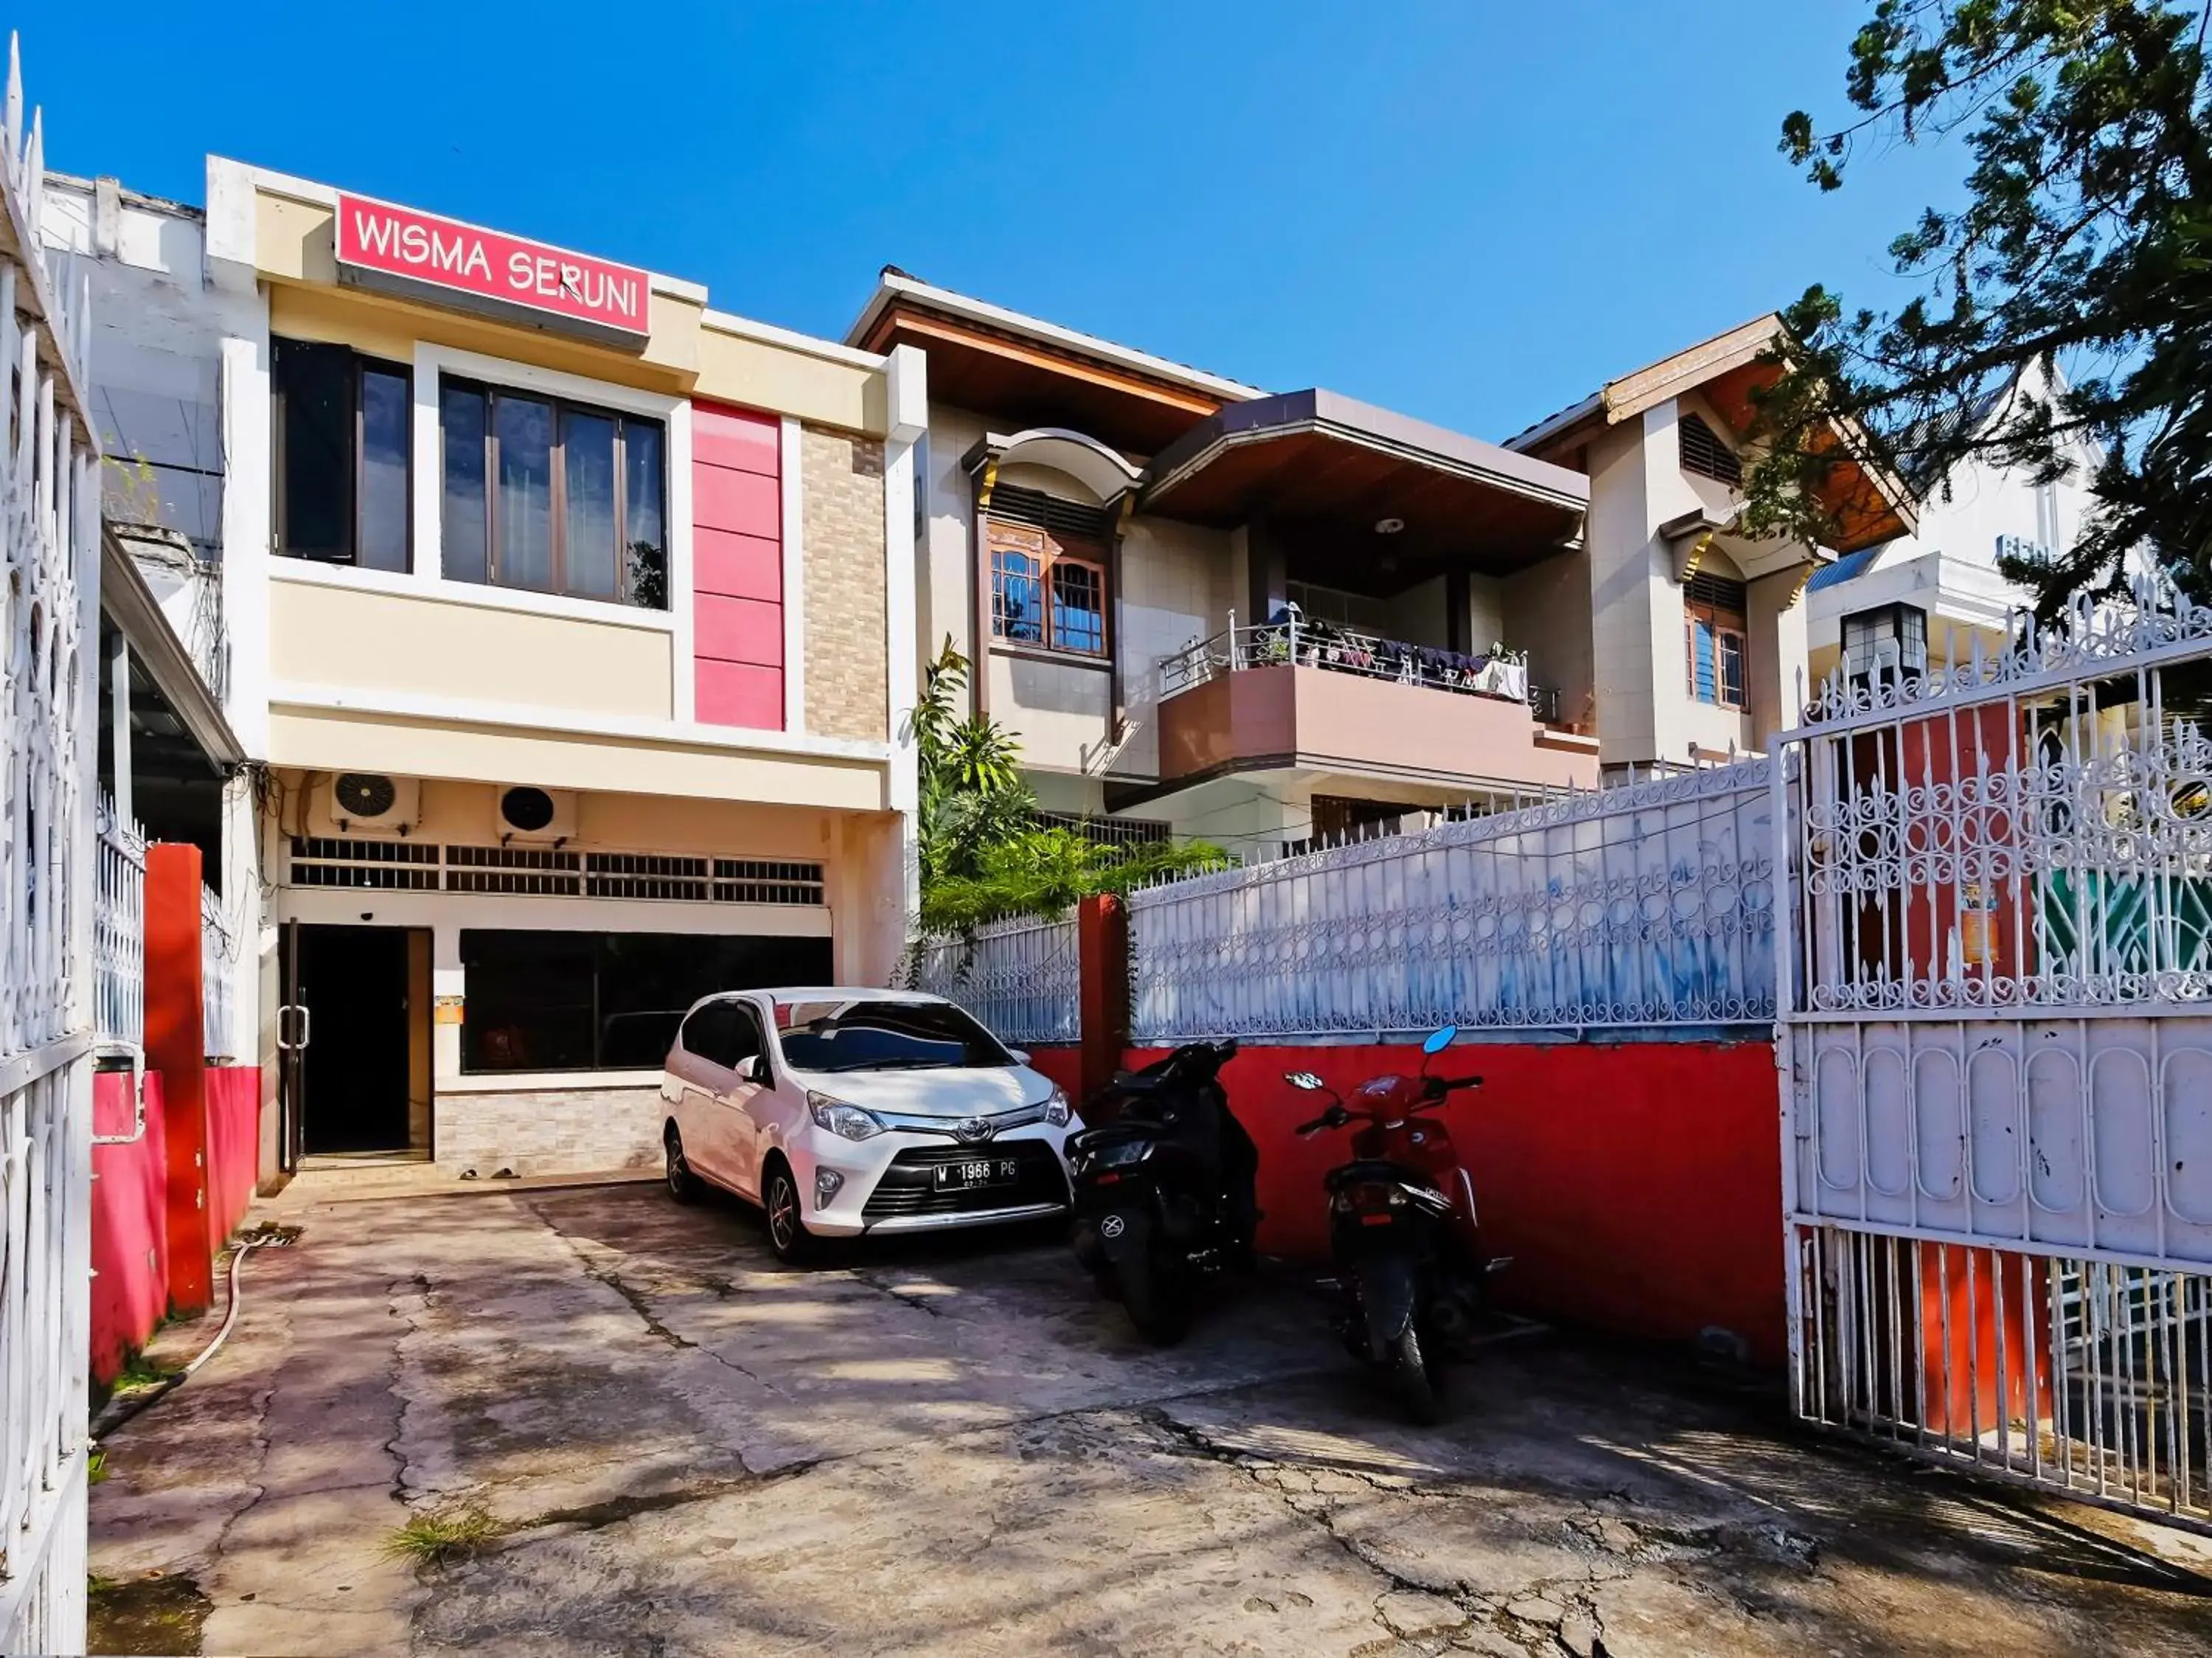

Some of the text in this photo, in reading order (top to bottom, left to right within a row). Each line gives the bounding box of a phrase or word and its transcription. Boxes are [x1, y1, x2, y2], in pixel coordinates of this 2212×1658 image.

[355, 210, 637, 317] WISMA SERUNI
[938, 1161, 1015, 1182] W 1966 PG
